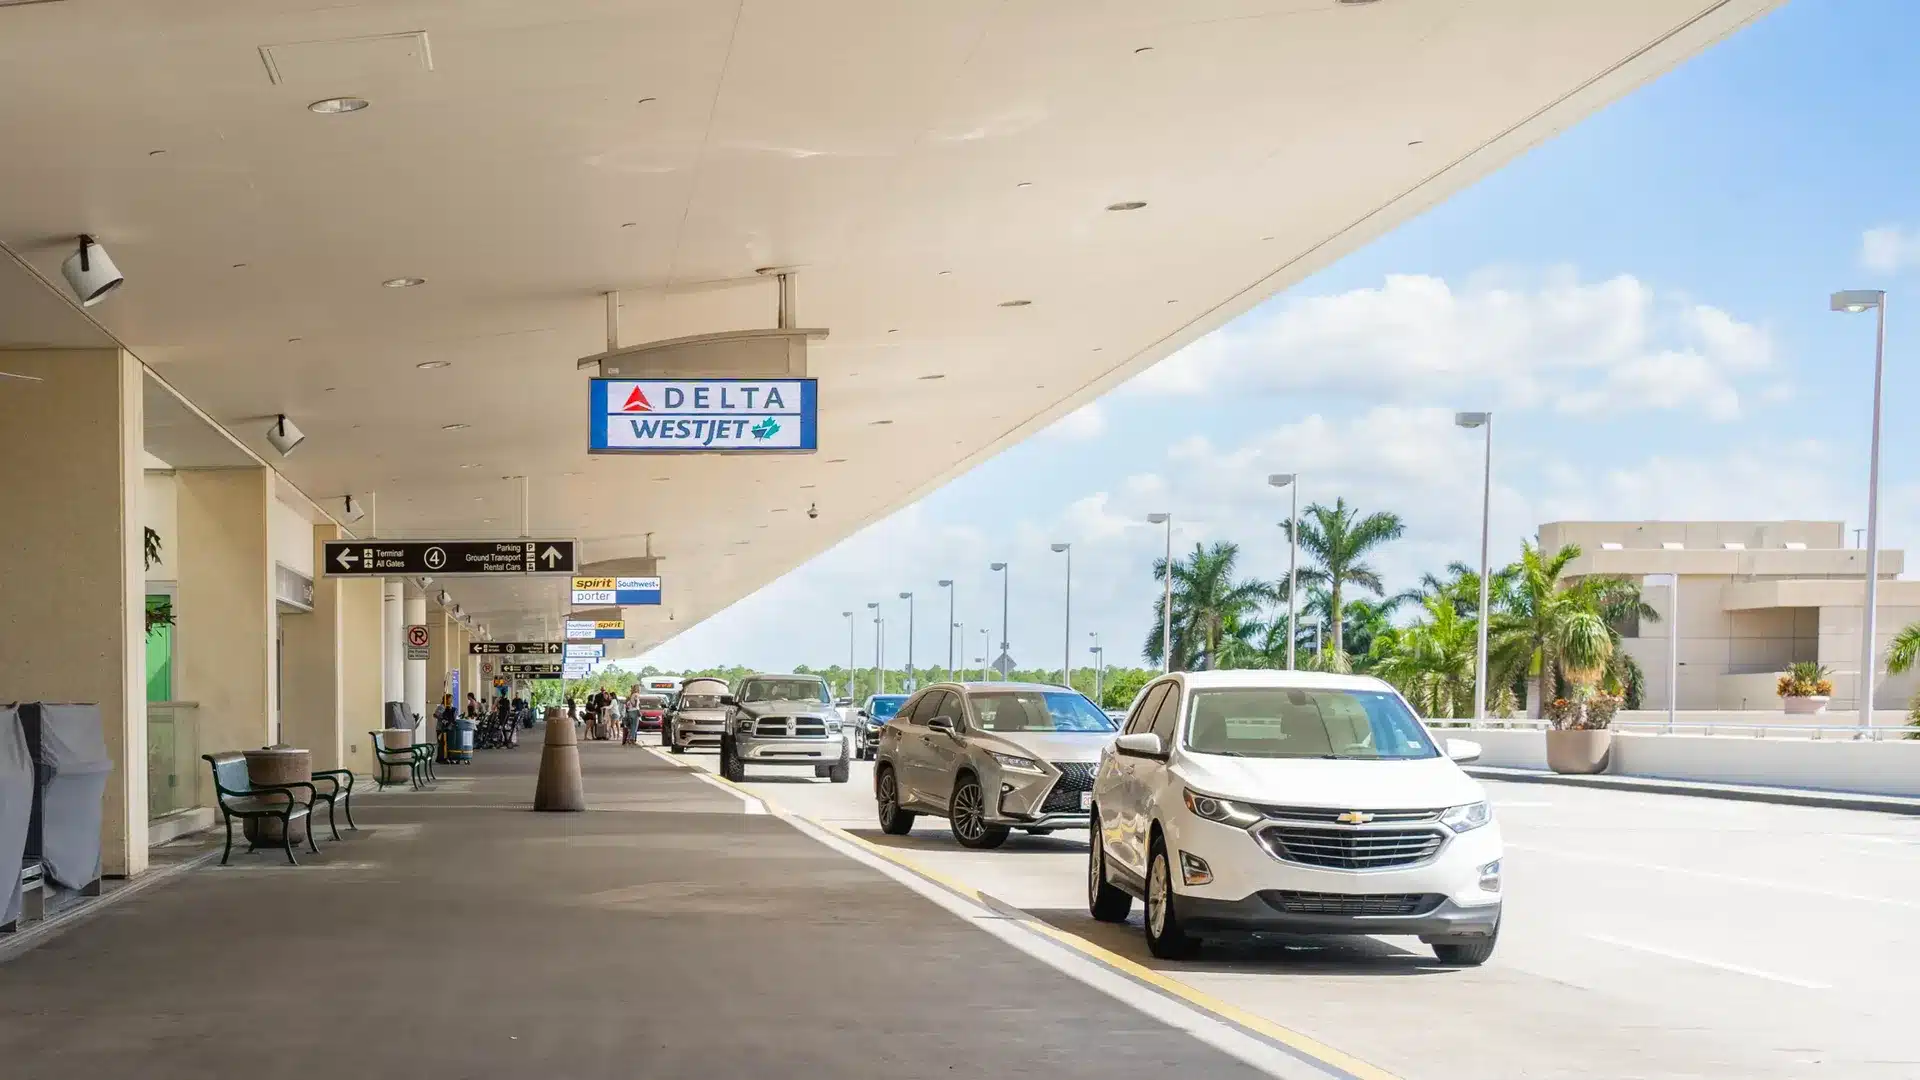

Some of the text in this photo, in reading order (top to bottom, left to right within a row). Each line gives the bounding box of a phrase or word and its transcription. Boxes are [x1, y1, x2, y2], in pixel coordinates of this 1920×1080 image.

[664, 387, 785, 409] DELTA
[630, 419, 750, 446] WESTJET
[376, 549, 404, 557] Terminal
[496, 544, 521, 553] Parking
[429, 551, 440, 565] 4
[465, 553, 521, 563] Ground Transport
[376, 559, 405, 568] All Gates
[483, 563, 521, 571] Rental Cars
[576, 578, 613, 589] spirit
[617, 580, 655, 588] Southwest
[577, 591, 610, 602] porter
[597, 621, 621, 629] spirit
